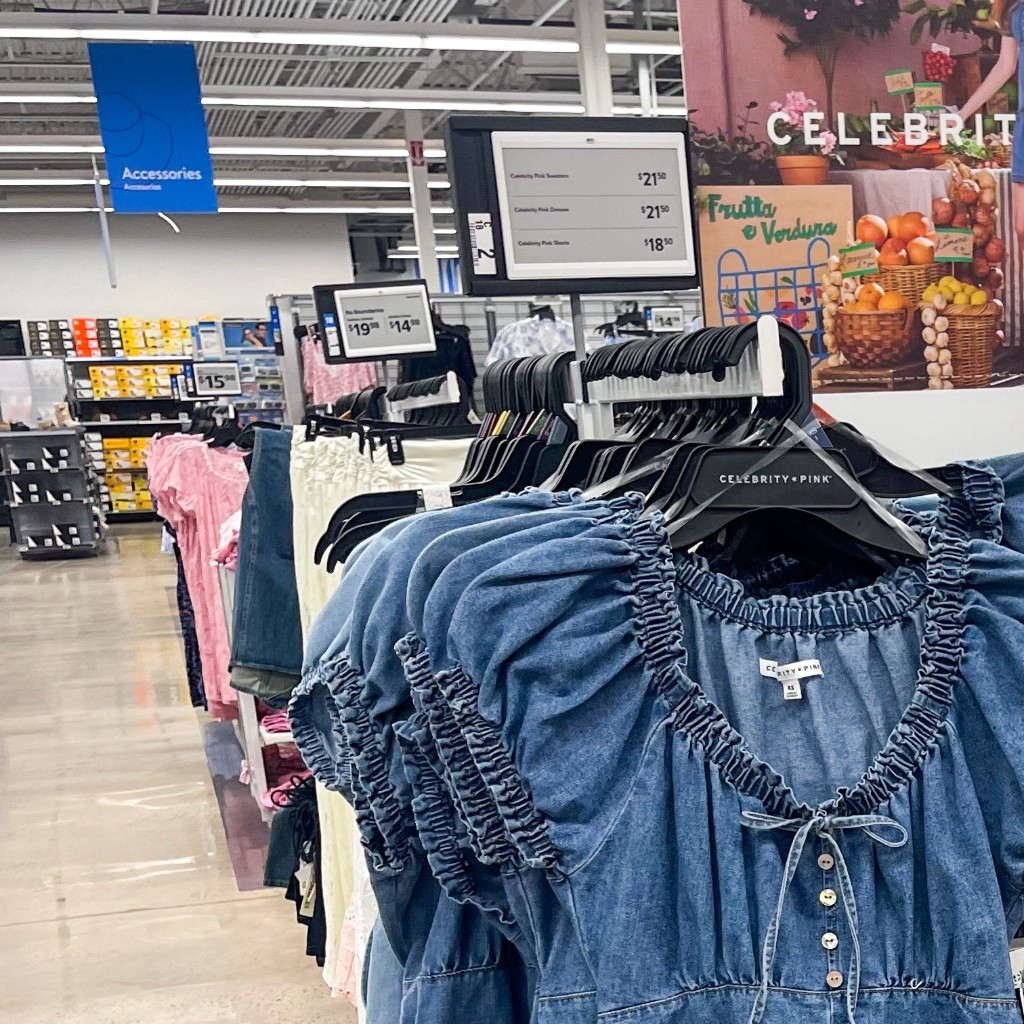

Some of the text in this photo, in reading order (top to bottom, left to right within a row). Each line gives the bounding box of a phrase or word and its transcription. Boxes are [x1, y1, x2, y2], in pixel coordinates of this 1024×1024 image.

[122, 167, 202, 180] Accessories
[707, 193, 777, 223] Frutta
[761, 217, 837, 246] Verdura
[719, 474, 789, 484] CELEBRITY
